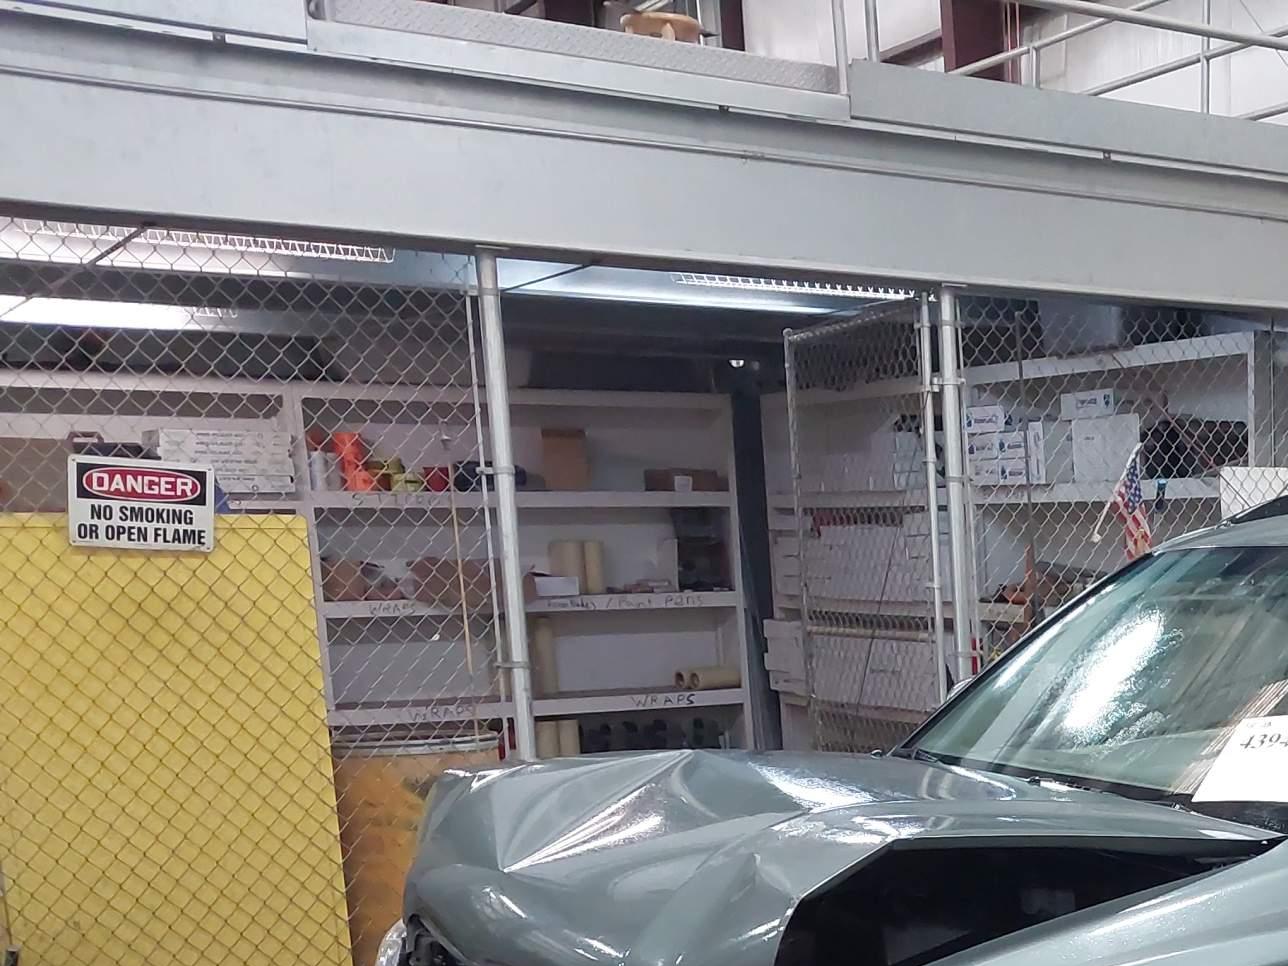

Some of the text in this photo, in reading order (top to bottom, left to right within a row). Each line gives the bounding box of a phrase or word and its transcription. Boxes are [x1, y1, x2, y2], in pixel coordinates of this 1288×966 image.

[92, 472, 193, 497] DANGER
[90, 503, 194, 525] NO SMOKING
[77, 523, 206, 546] OR OPEN FLAME
[631, 693, 696, 707] WRAPS
